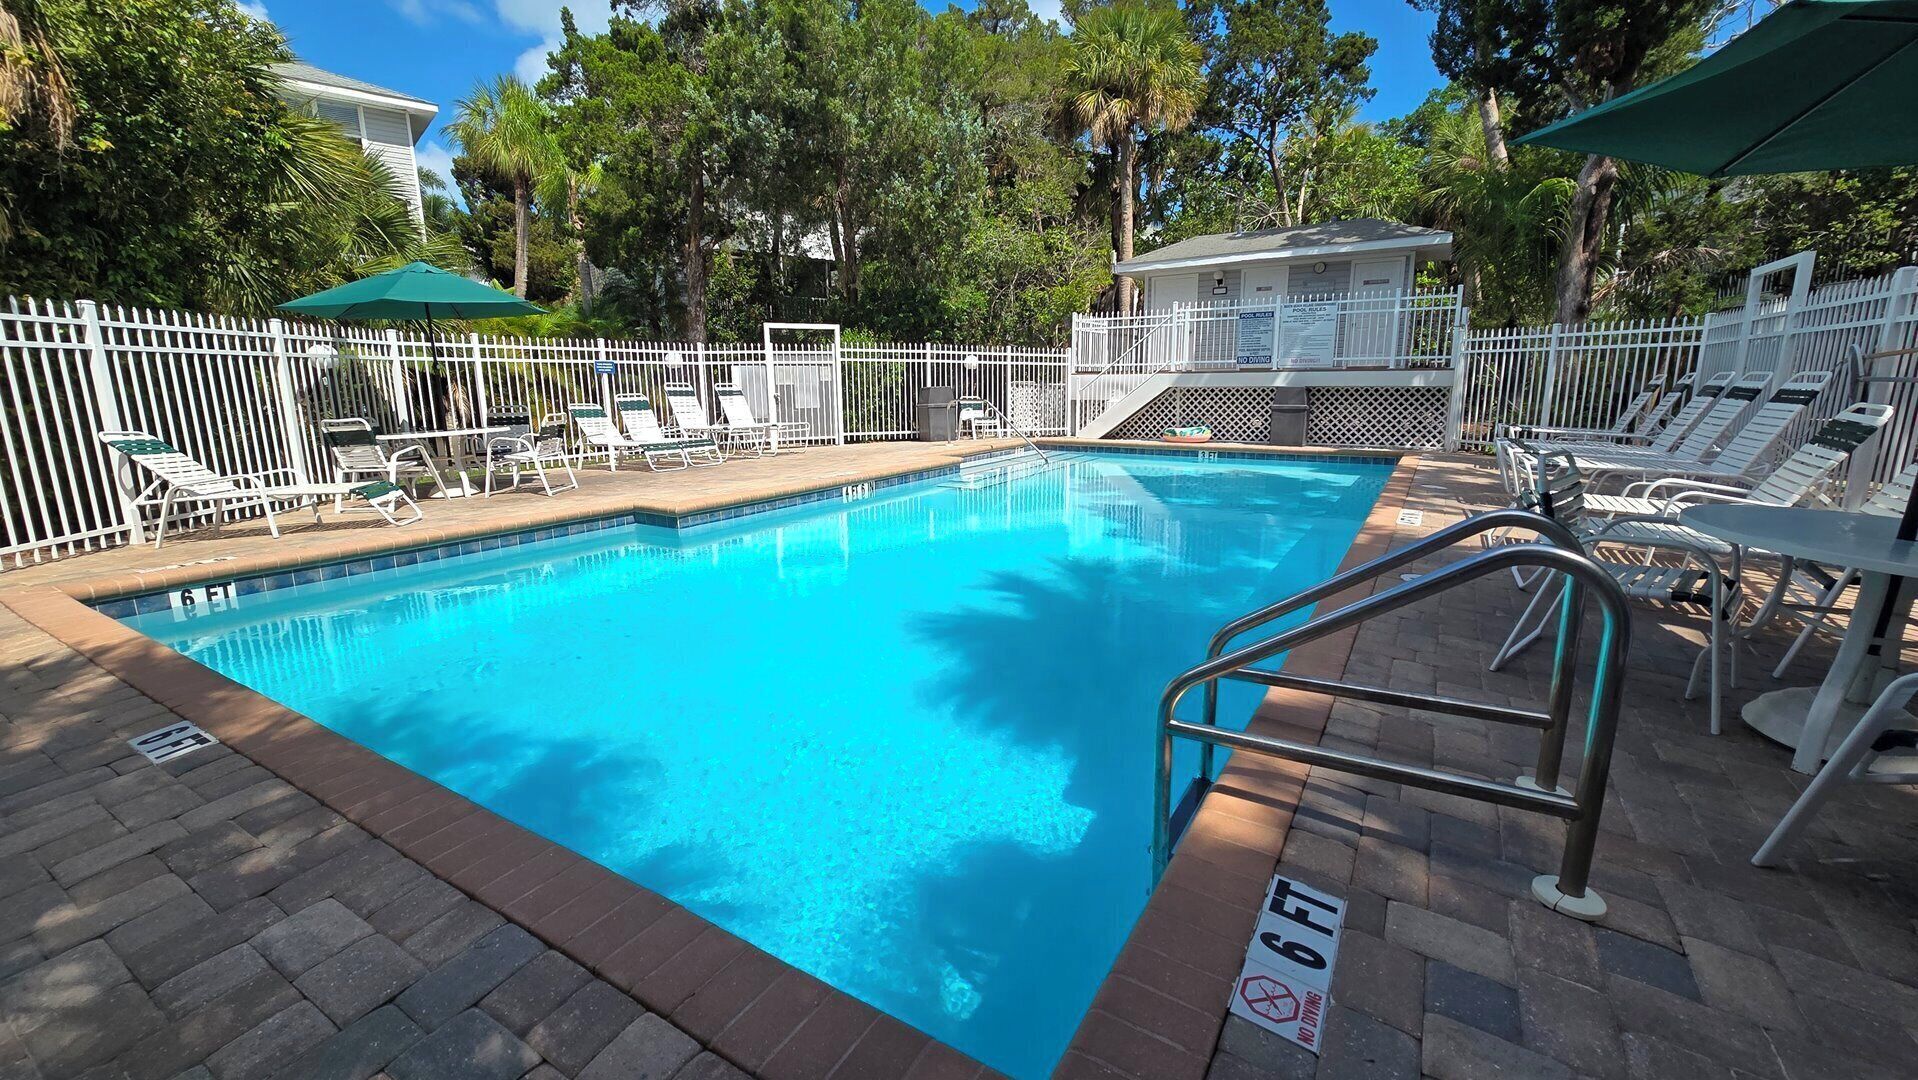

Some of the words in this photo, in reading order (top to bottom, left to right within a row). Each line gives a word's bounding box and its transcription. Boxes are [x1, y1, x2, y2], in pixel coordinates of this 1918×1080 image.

[180, 588, 196, 607] 6
[204, 581, 232, 602] FT
[136, 726, 190, 746] 6
[146, 732, 212, 759] FT
[1268, 878, 1338, 938] FT
[1259, 931, 1328, 970] 6
[1300, 990, 1323, 1029] DIVING
[1297, 1030, 1315, 1047] NO
